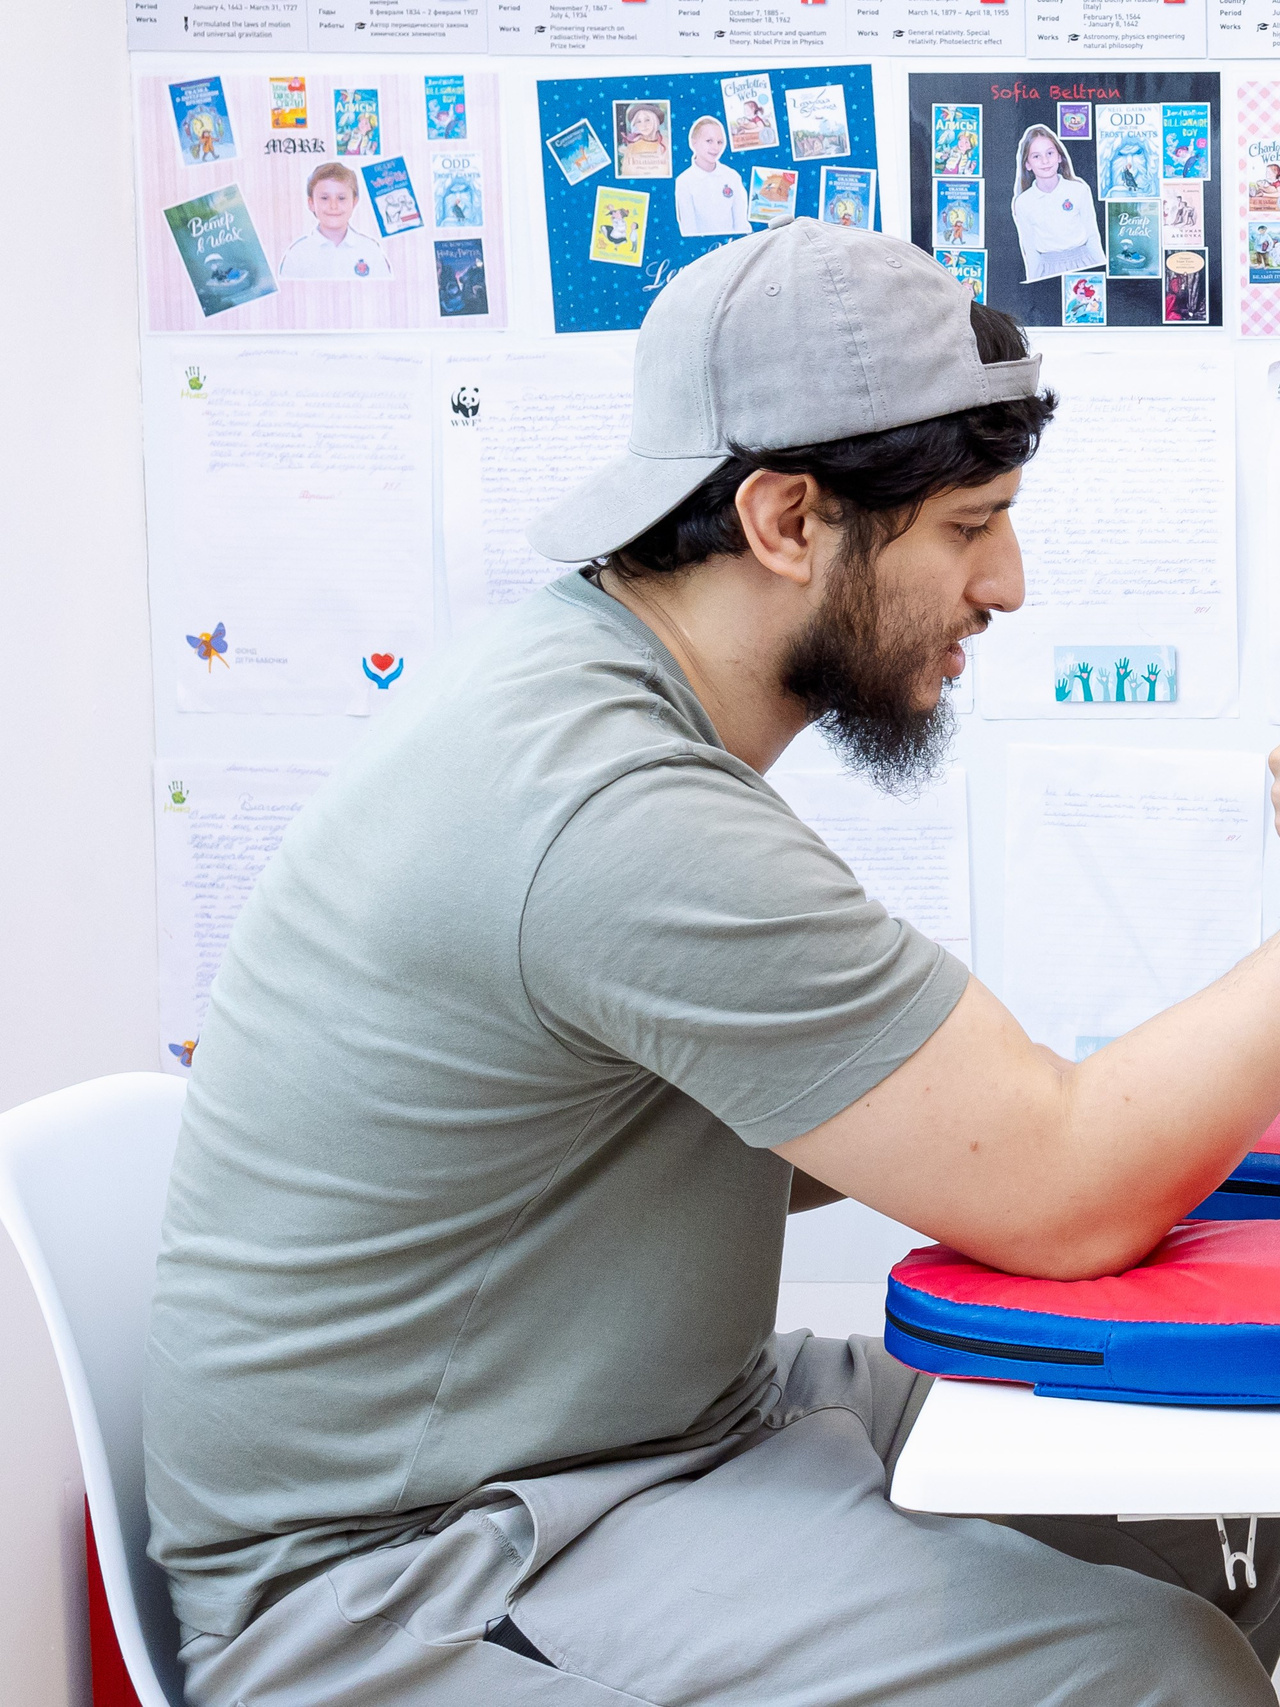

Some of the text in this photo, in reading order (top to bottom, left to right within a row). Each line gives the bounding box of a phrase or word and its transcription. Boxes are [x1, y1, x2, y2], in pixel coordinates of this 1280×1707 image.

[192, 20, 231, 28] Formulated
[935, 29, 965, 37] relativity.
[966, 29, 990, 37] Special
[1083, 33, 1185, 41] Astronomy, physics engineering
[799, 38, 824, 46] Physics
[908, 38, 938, 46] relativity.
[1108, 42, 1144, 50] philosophy
[724, 77, 767, 97] Charlotte's
[991, 81, 1121, 103] Sofia Beltran
[737, 89, 758, 101] Web
[1110, 113, 1145, 126] ODD
[1100, 130, 1158, 139] FROST GIANTS
[1182, 128, 1198, 137] BOY
[264, 138, 325, 156] MARK
[442, 158, 470, 169] ODD
[188, 212, 234, 238] Ветер
[1118, 213, 1149, 227] Ветер
